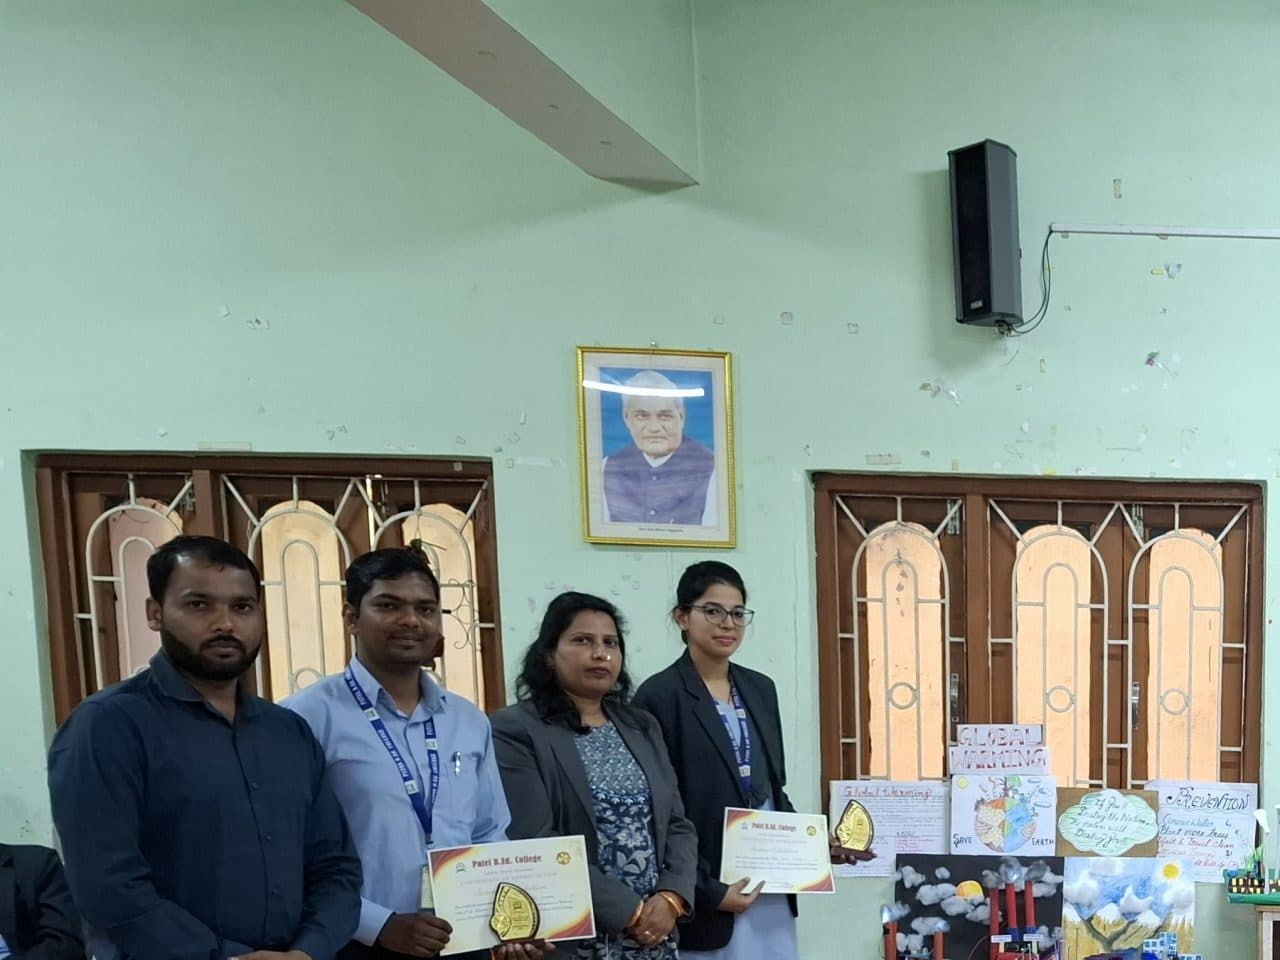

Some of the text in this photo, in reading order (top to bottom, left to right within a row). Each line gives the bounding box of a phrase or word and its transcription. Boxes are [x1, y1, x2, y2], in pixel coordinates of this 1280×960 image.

[959, 727, 1042, 746] GLOBAL
[951, 748, 1046, 769] WARMING
[843, 786, 932, 800] Global Warming
[1165, 786, 1250, 811] PREVENTION
[1108, 825, 1128, 833] will
[1160, 824, 1182, 835] Plant
[1031, 837, 1054, 846] EARTH
[472, 854, 542, 869] Patel B.Ed. College
